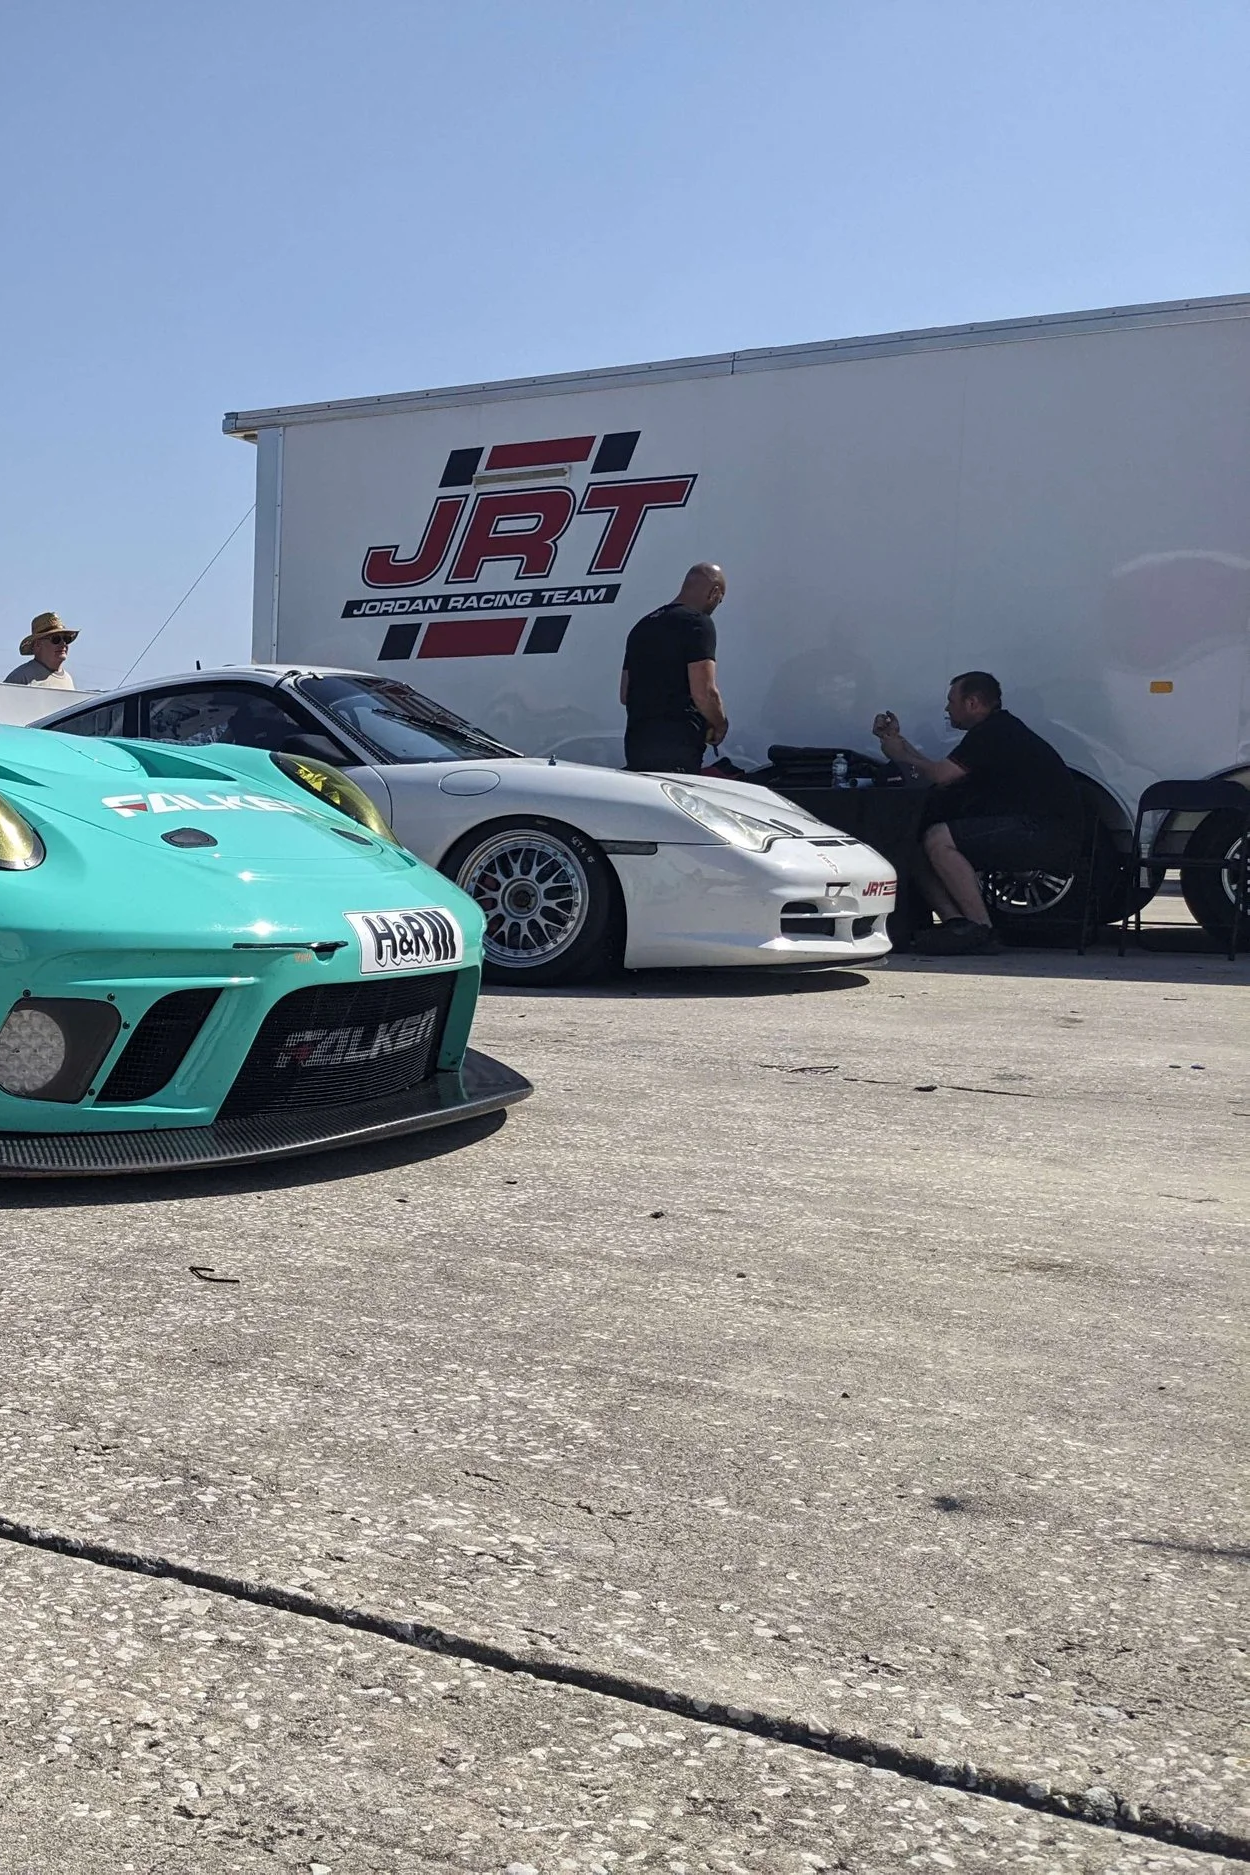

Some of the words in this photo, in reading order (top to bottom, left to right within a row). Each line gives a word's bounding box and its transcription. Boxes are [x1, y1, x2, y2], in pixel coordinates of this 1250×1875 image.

[361, 473, 699, 589] JRT
[353, 599, 441, 616] JORDAN
[448, 591, 533, 611] RACING
[540, 587, 607, 604] TEAM
[862, 881, 884, 897] JRT
[273, 1006, 438, 1068] FALKEN
